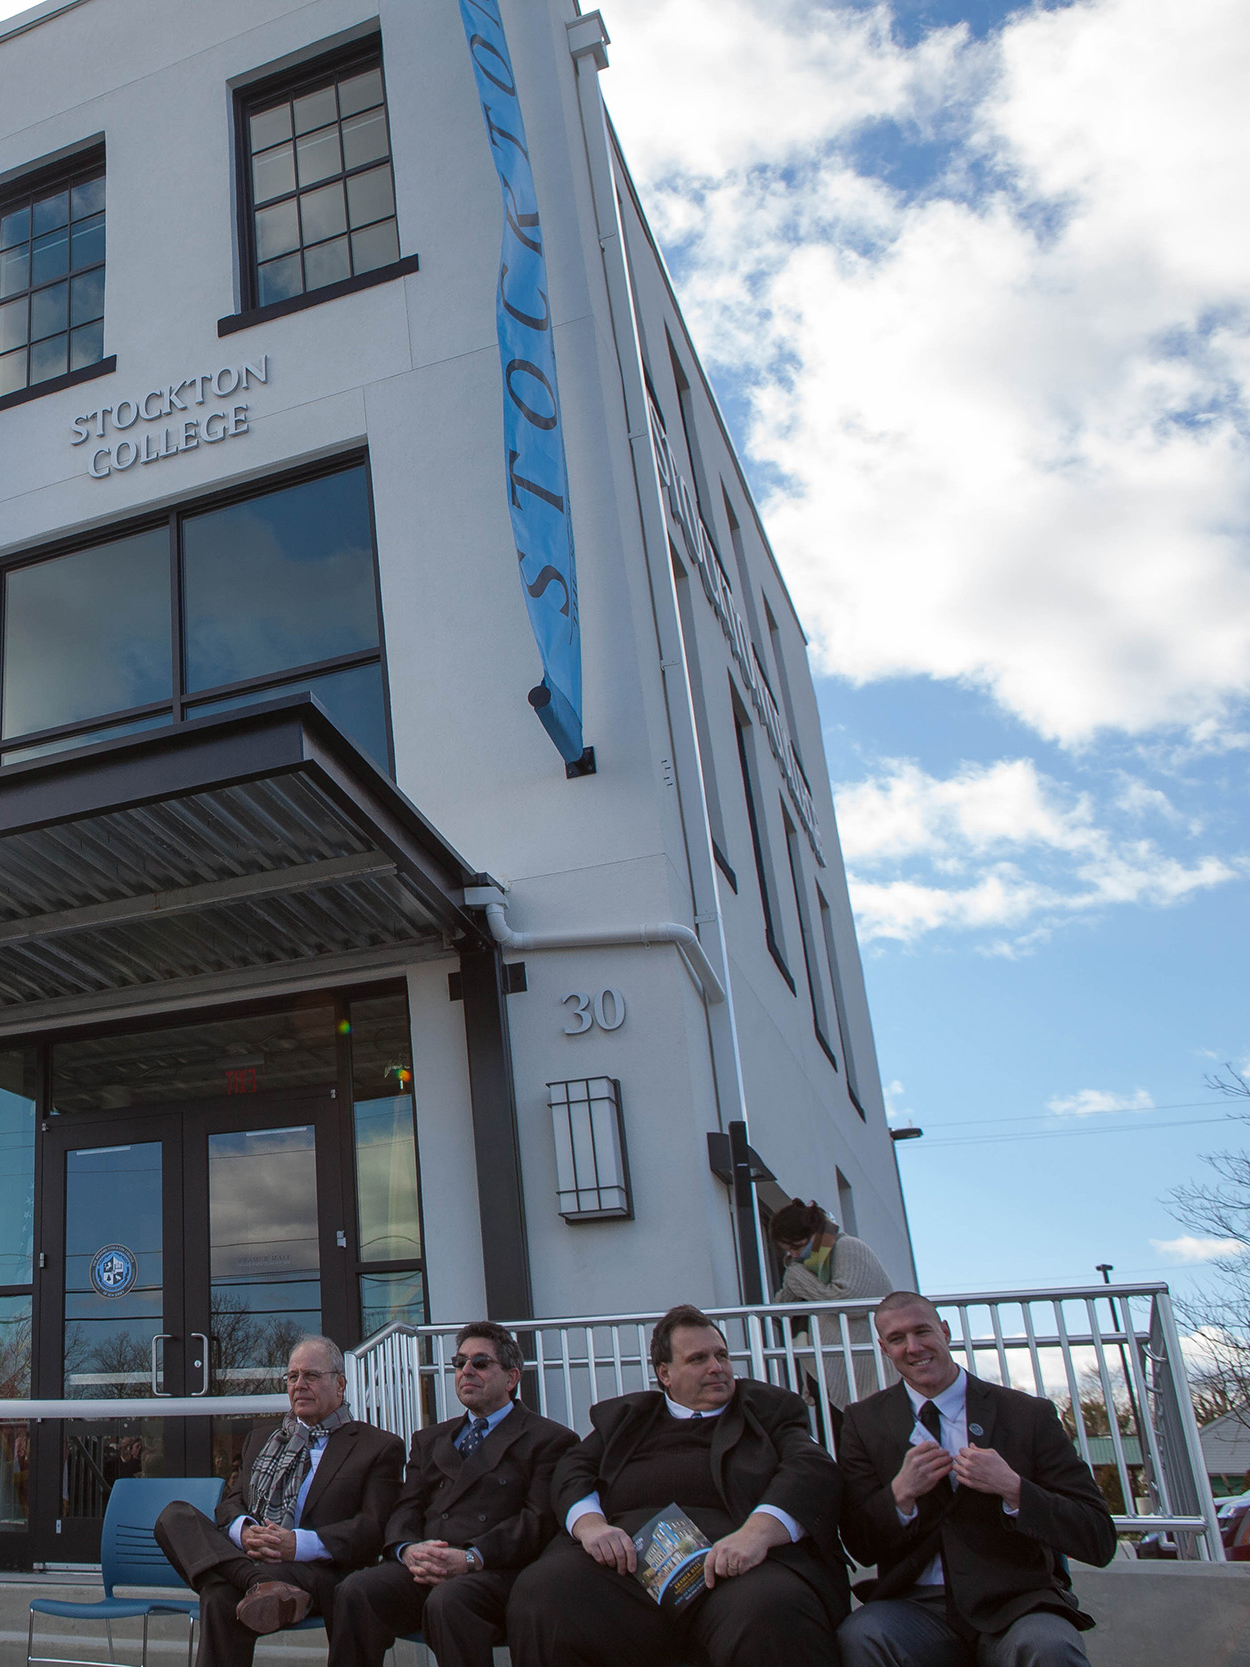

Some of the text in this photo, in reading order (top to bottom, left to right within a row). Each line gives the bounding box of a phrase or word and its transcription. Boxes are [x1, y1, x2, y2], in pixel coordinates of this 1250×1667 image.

[70, 355, 269, 446] STOCKTON
[87, 404, 250, 479] COLLEGE
[561, 988, 626, 1036] 30
